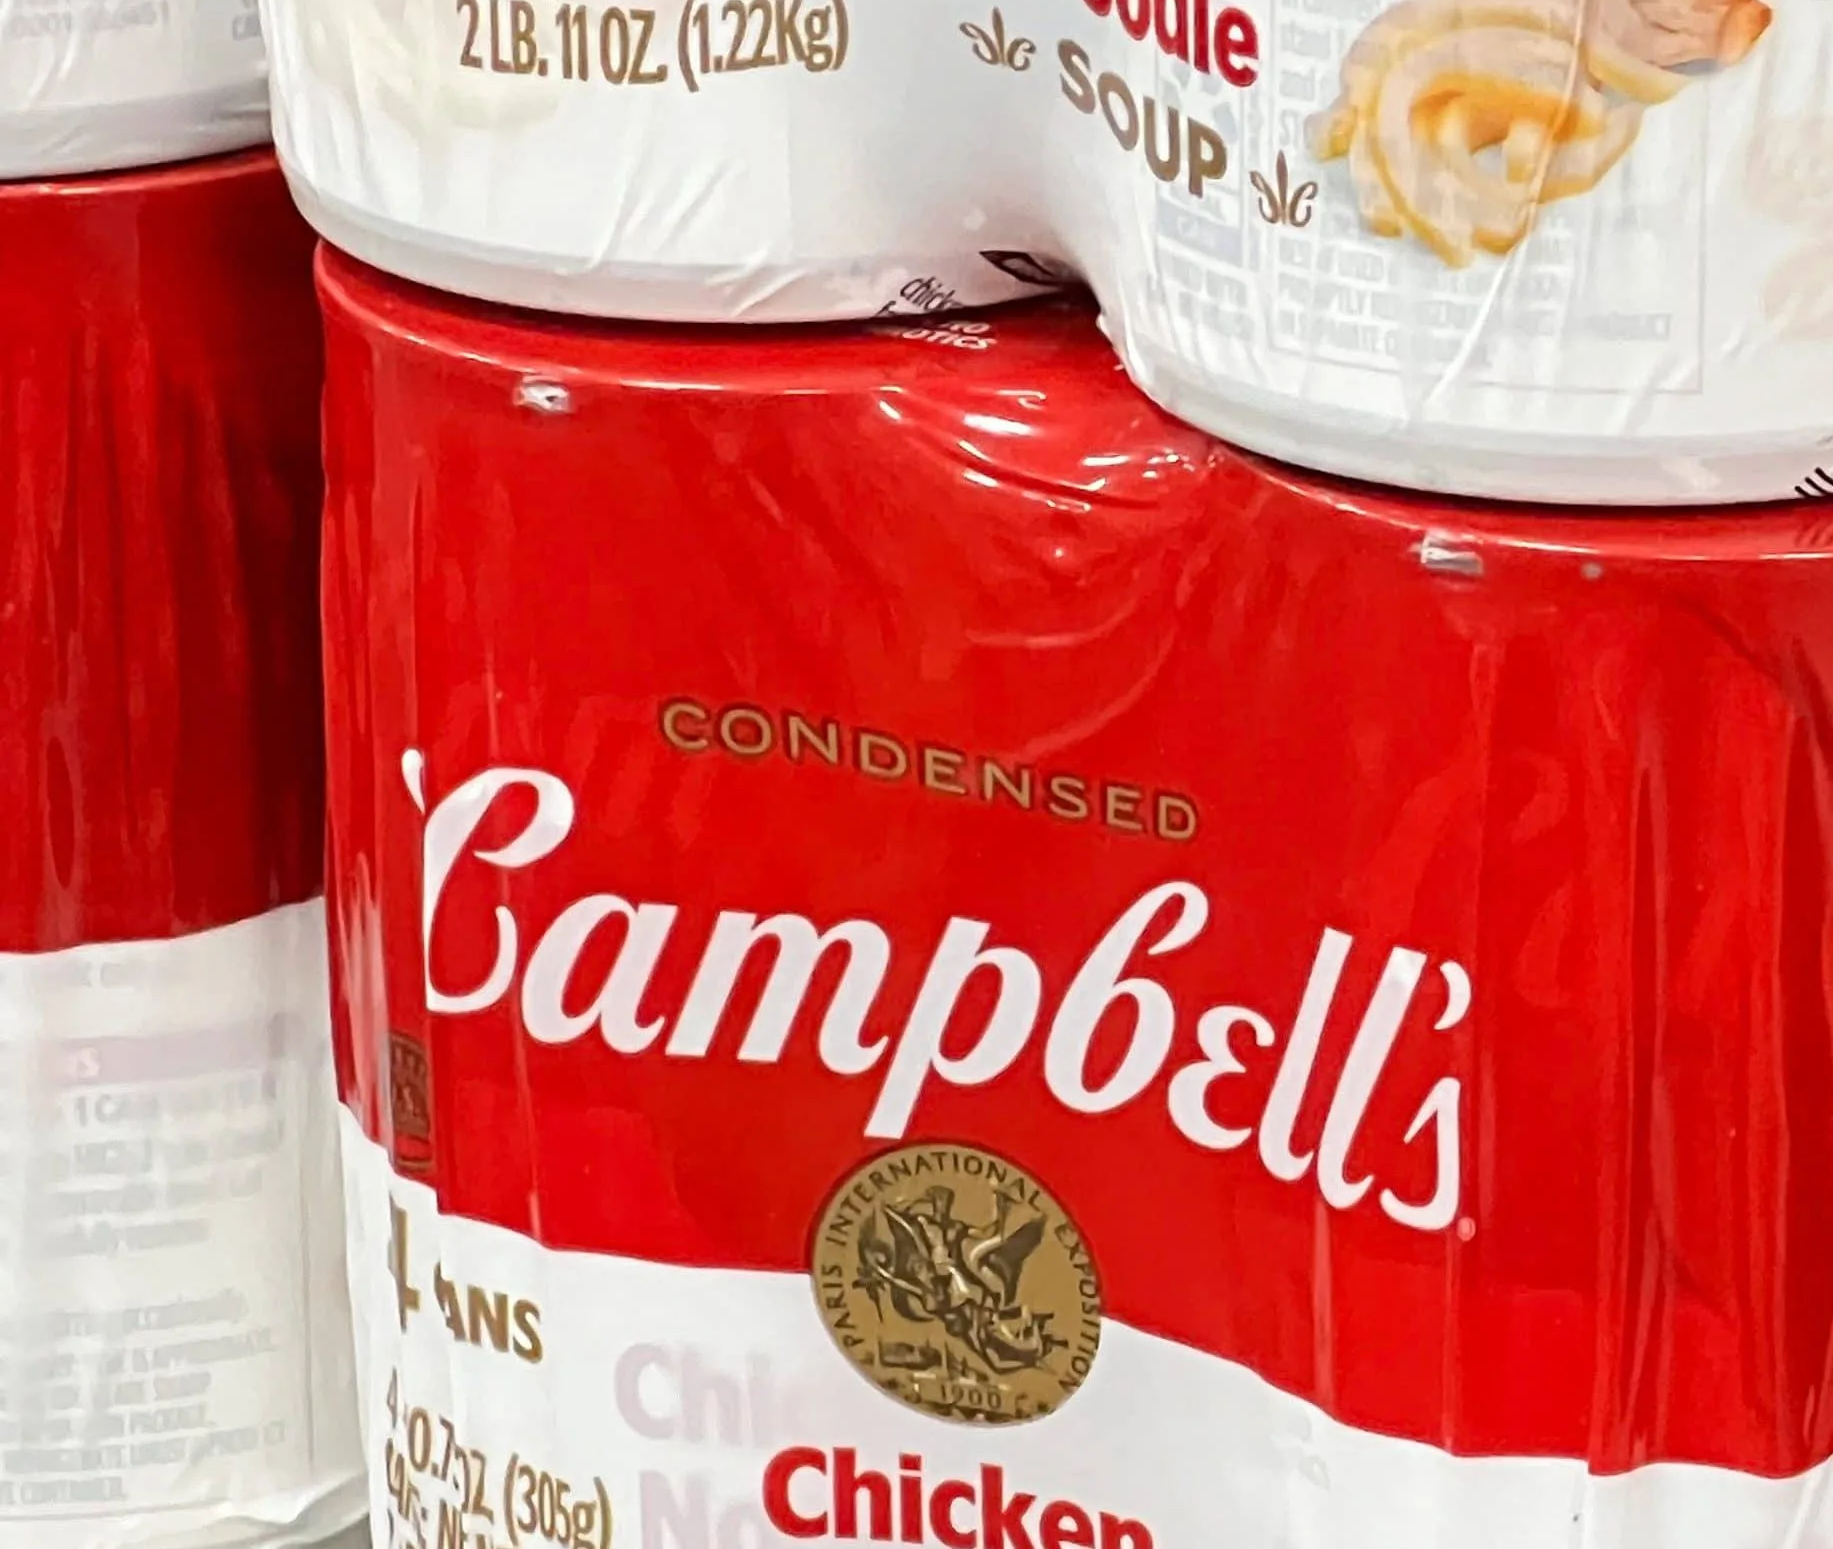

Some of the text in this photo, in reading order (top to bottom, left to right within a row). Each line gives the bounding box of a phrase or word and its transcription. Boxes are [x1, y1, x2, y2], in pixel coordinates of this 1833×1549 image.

[489, 0, 549, 79] LB.
[557, 6, 591, 83] 11
[601, 8, 668, 85] OZ.
[1058, 38, 1228, 199] SOUP
[659, 700, 1198, 842] CONDENSED
[401, 747, 1476, 1231] Campbell's
[821, 1263, 865, 1349] PARIS
[825, 1151, 1101, 1393] INTERNATIONAL EXPOSITION
